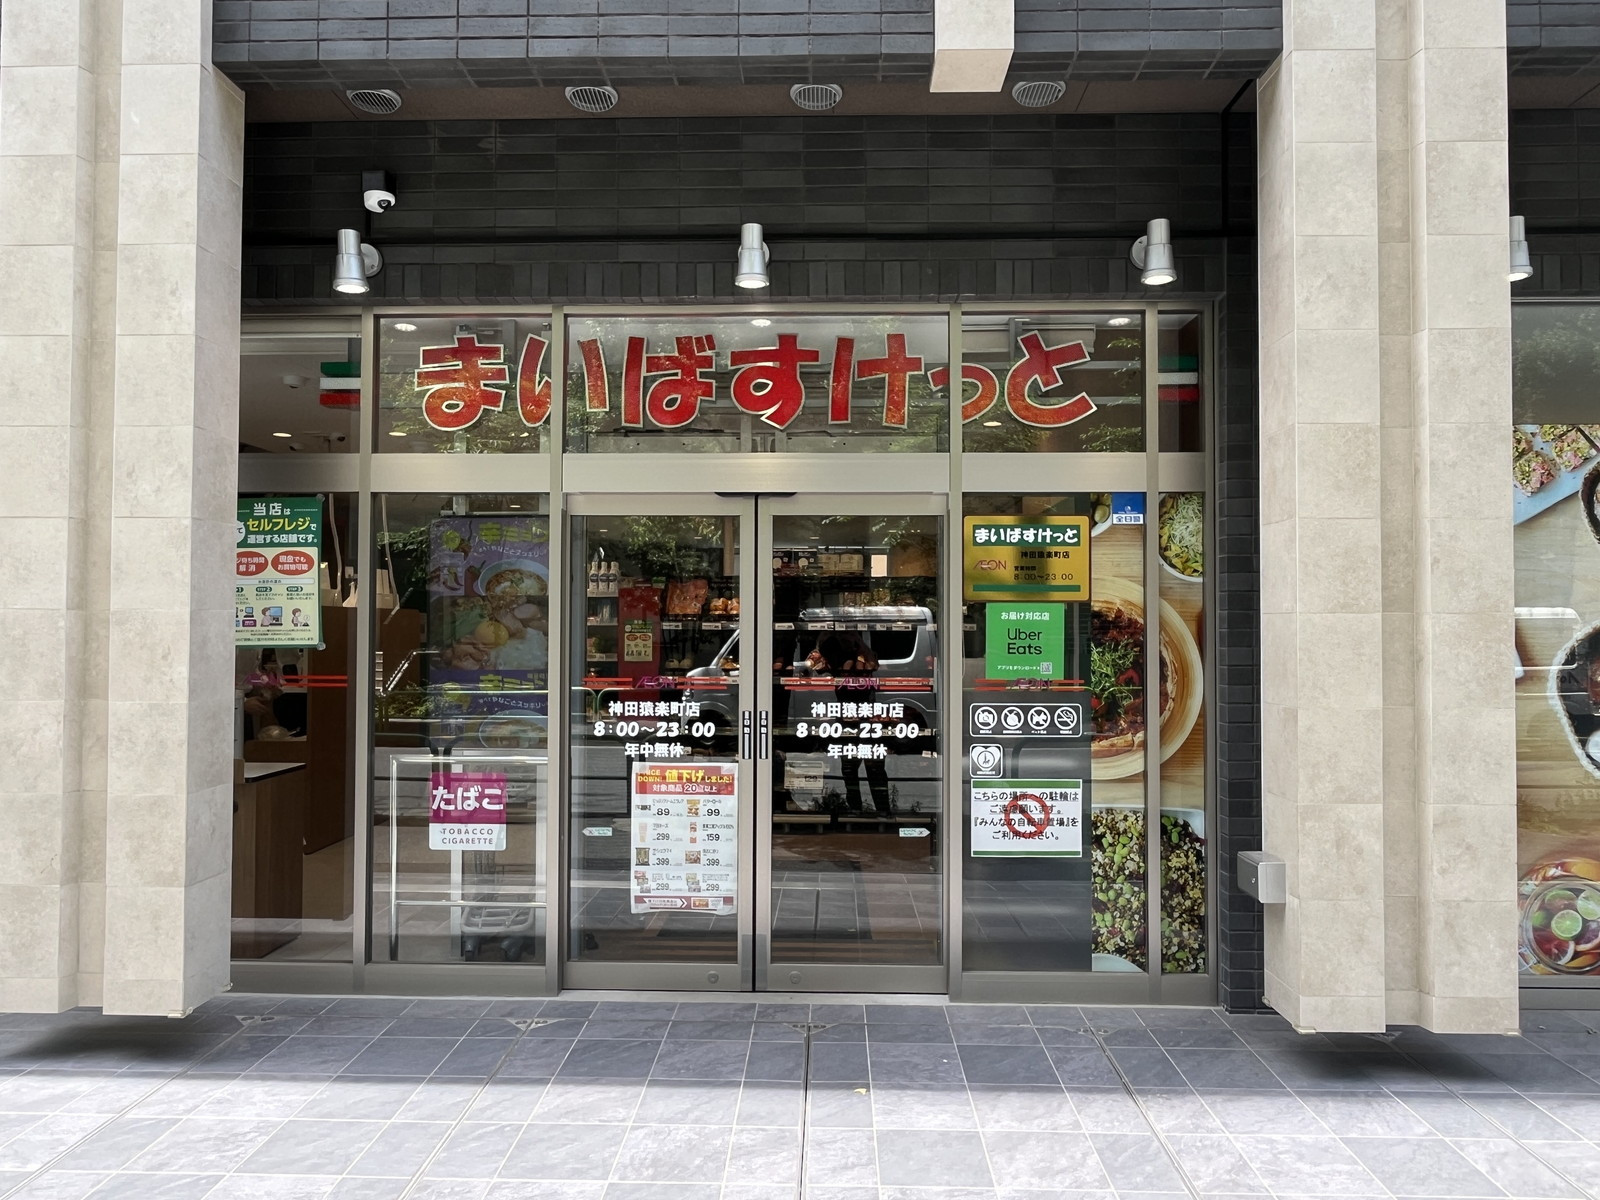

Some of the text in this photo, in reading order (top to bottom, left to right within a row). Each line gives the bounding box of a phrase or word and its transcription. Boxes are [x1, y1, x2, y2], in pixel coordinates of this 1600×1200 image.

[414, 330, 1098, 431] まいばすけっと
[253, 503, 291, 516] 当店は
[247, 517, 317, 531] セルフレジで
[247, 533, 318, 544] 運営する店舗です。
[974, 528, 1078, 543] まいばすけっと
[279, 555, 306, 563] 現金でも
[1001, 612, 1050, 620] お届け対応店
[1007, 628, 1042, 640] Uber
[1007, 643, 1042, 654] Eats
[608, 701, 700, 717] 神田猿楽町店
[811, 702, 904, 718] 神田猿楽町店
[624, 742, 685, 758] 年中無休
[827, 743, 888, 759] 年中無休
[432, 785, 504, 810] たばこ
[656, 807, 670, 816] 89
[706, 808, 720, 817] 99
[656, 832, 670, 841] 299
[706, 833, 720, 841] 159
[992, 830, 1059, 840] ご利用ください。
[441, 837, 494, 845] CIGARETTE
[656, 857, 670, 866] 399
[706, 858, 720, 866] 399
[656, 883, 670, 891] 299
